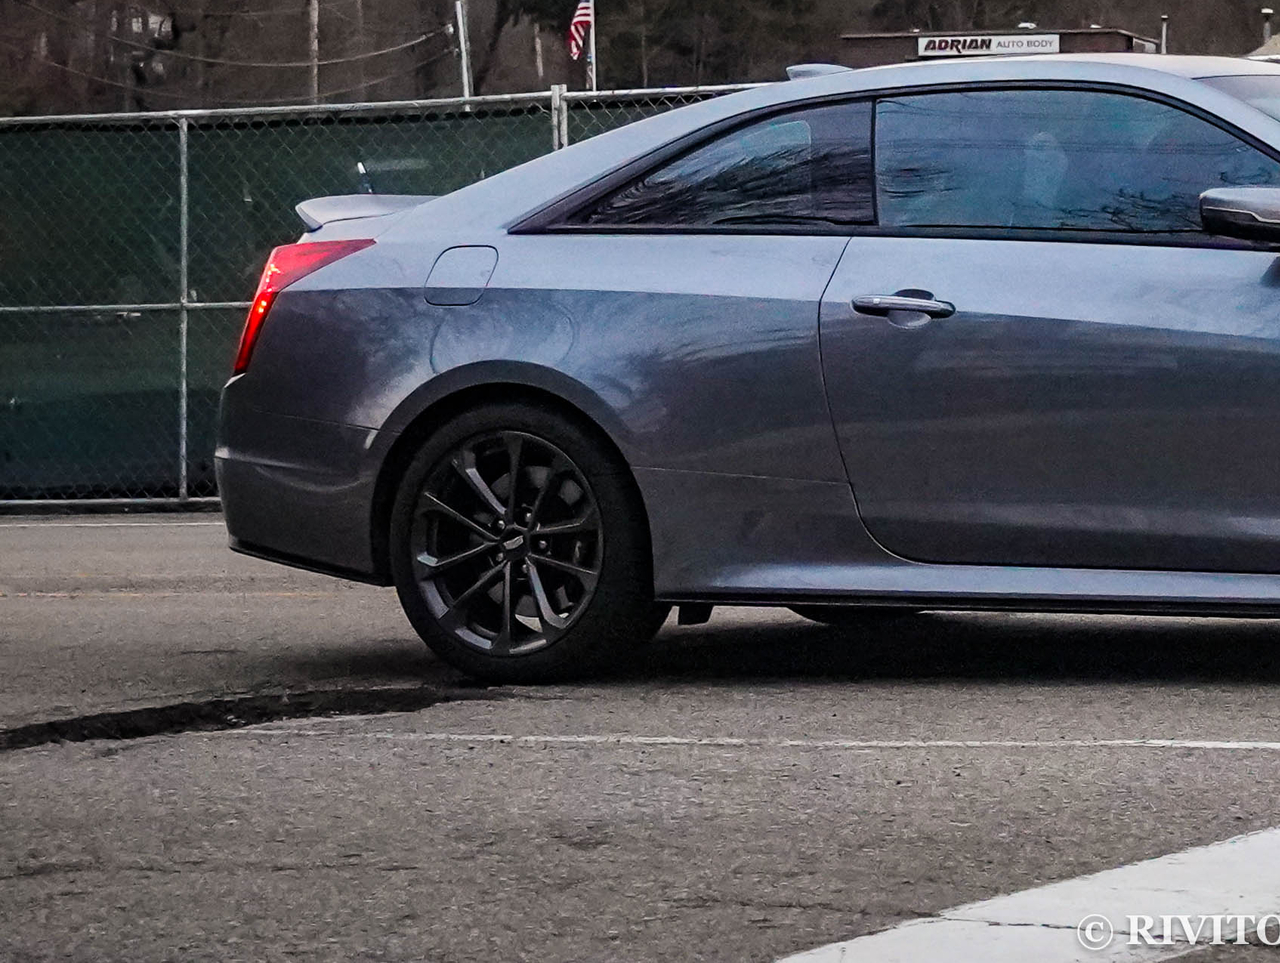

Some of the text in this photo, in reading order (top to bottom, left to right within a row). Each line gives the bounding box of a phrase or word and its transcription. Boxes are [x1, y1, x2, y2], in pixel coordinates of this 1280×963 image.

[924, 38, 1053, 53] ADRIAN AUTO BODY
